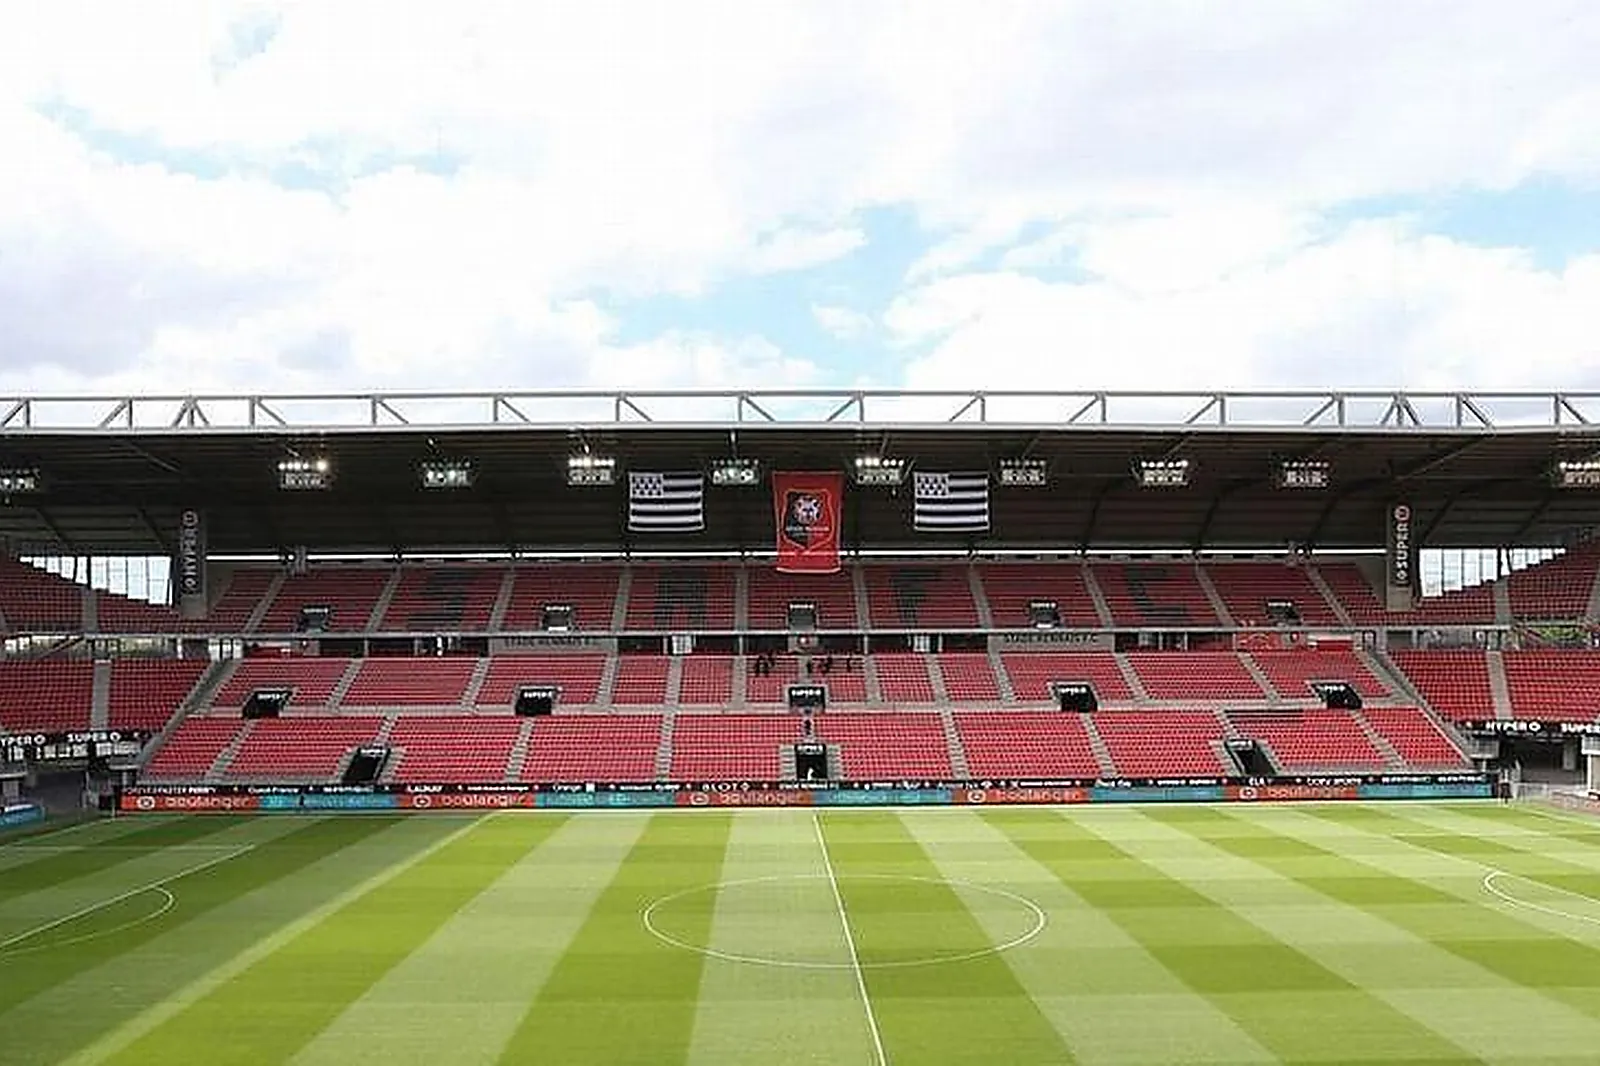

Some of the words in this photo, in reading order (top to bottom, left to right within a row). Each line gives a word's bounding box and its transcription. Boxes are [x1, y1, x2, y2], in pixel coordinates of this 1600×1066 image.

[183, 529, 198, 577] HYPER
[1395, 523, 1409, 569] SUPER
[66, 731, 108, 743] SUPER
[1485, 721, 1528, 732] HYPER
